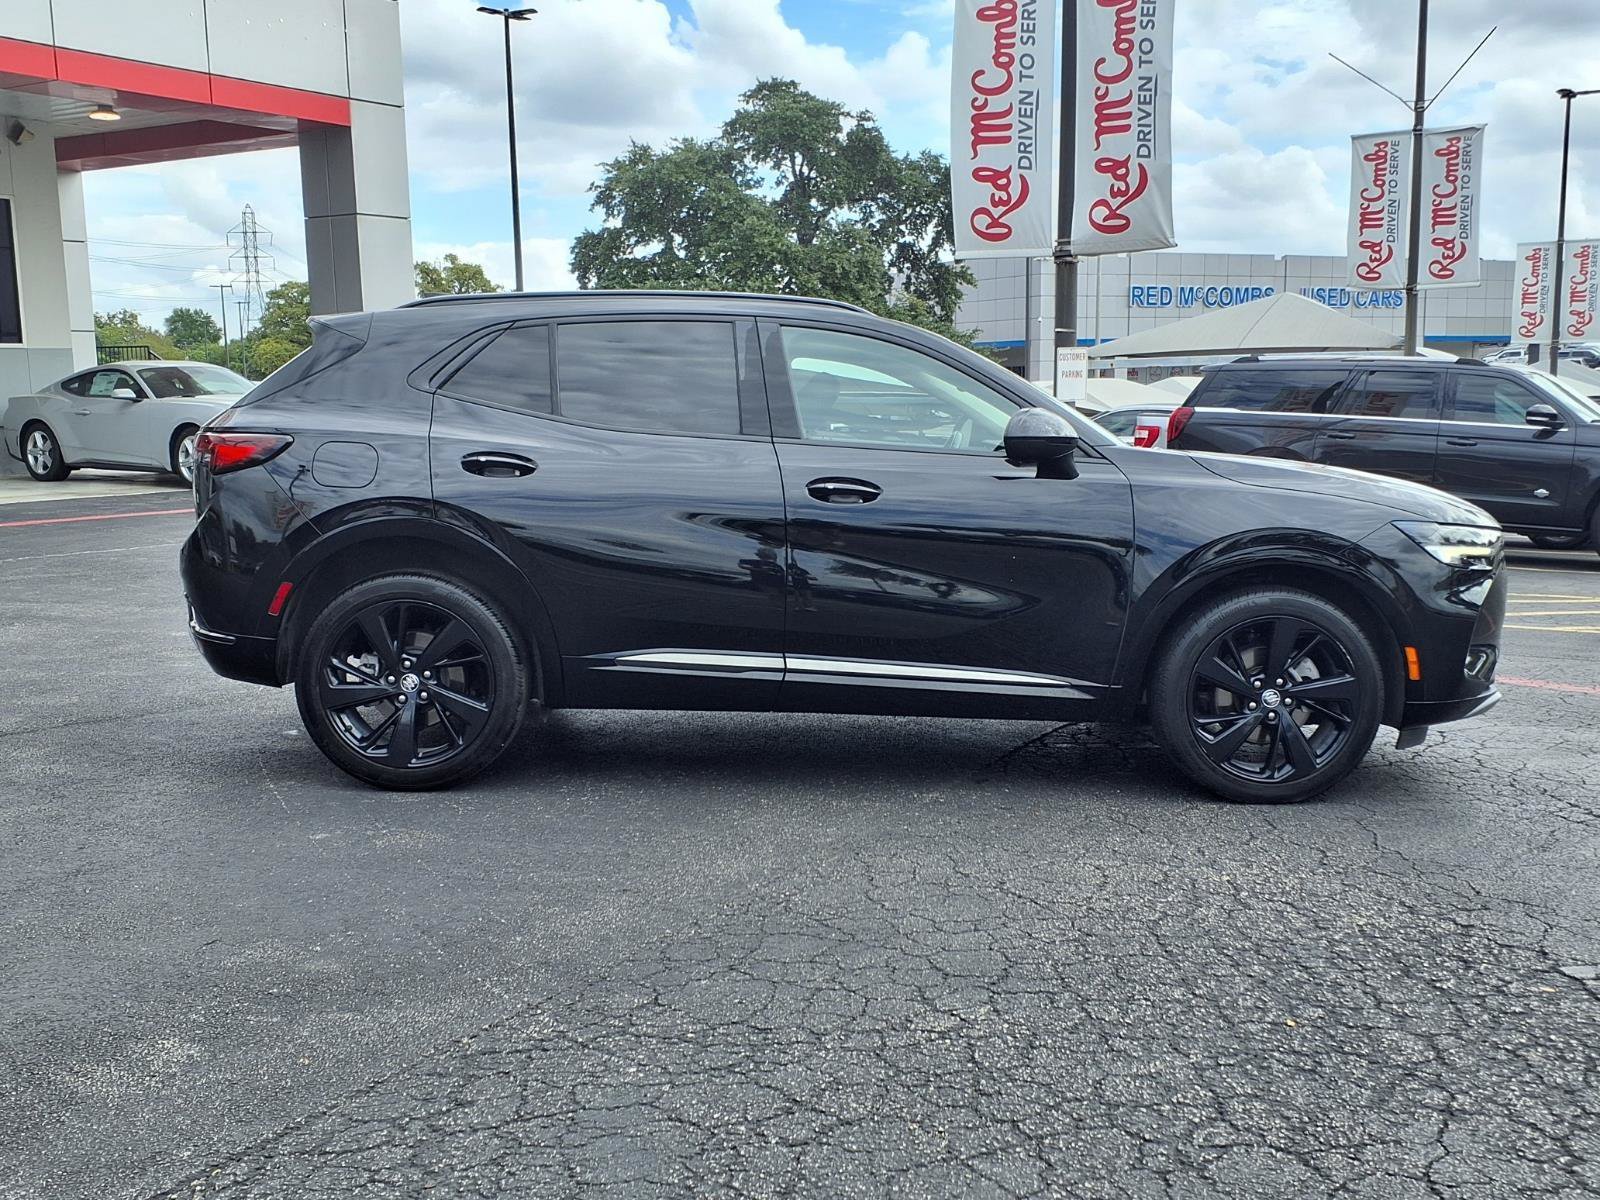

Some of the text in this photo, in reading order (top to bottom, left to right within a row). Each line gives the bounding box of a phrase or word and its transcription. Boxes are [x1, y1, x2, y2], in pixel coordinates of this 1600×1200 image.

[1019, 53, 1035, 84] TO
[1138, 38, 1155, 69] TO
[1018, 90, 1034, 172] DRIVEN
[1136, 76, 1153, 159] DRIVEN
[970, 165, 1030, 242] Red
[1089, 154, 1149, 235] Red
[1355, 140, 1393, 282] Red McCombs
[1386, 140, 1400, 243] DRIVEN TO SERVE
[1429, 136, 1467, 280] Red McCombs
[1459, 135, 1473, 239] DRIVEN TO SERVE
[1541, 273, 1548, 285] TO
[1542, 247, 1550, 271] SERVE
[1590, 271, 1597, 284] TO
[1591, 244, 1599, 269] SERVE
[1130, 286, 1173, 307] RED
[1355, 290, 1404, 307] CARS
[1519, 247, 1544, 339] Red McCombs
[1567, 244, 1593, 338] Red McCombs
[1059, 353, 1086, 361] CUSTOMER
[1061, 370, 1083, 378] PARKING
